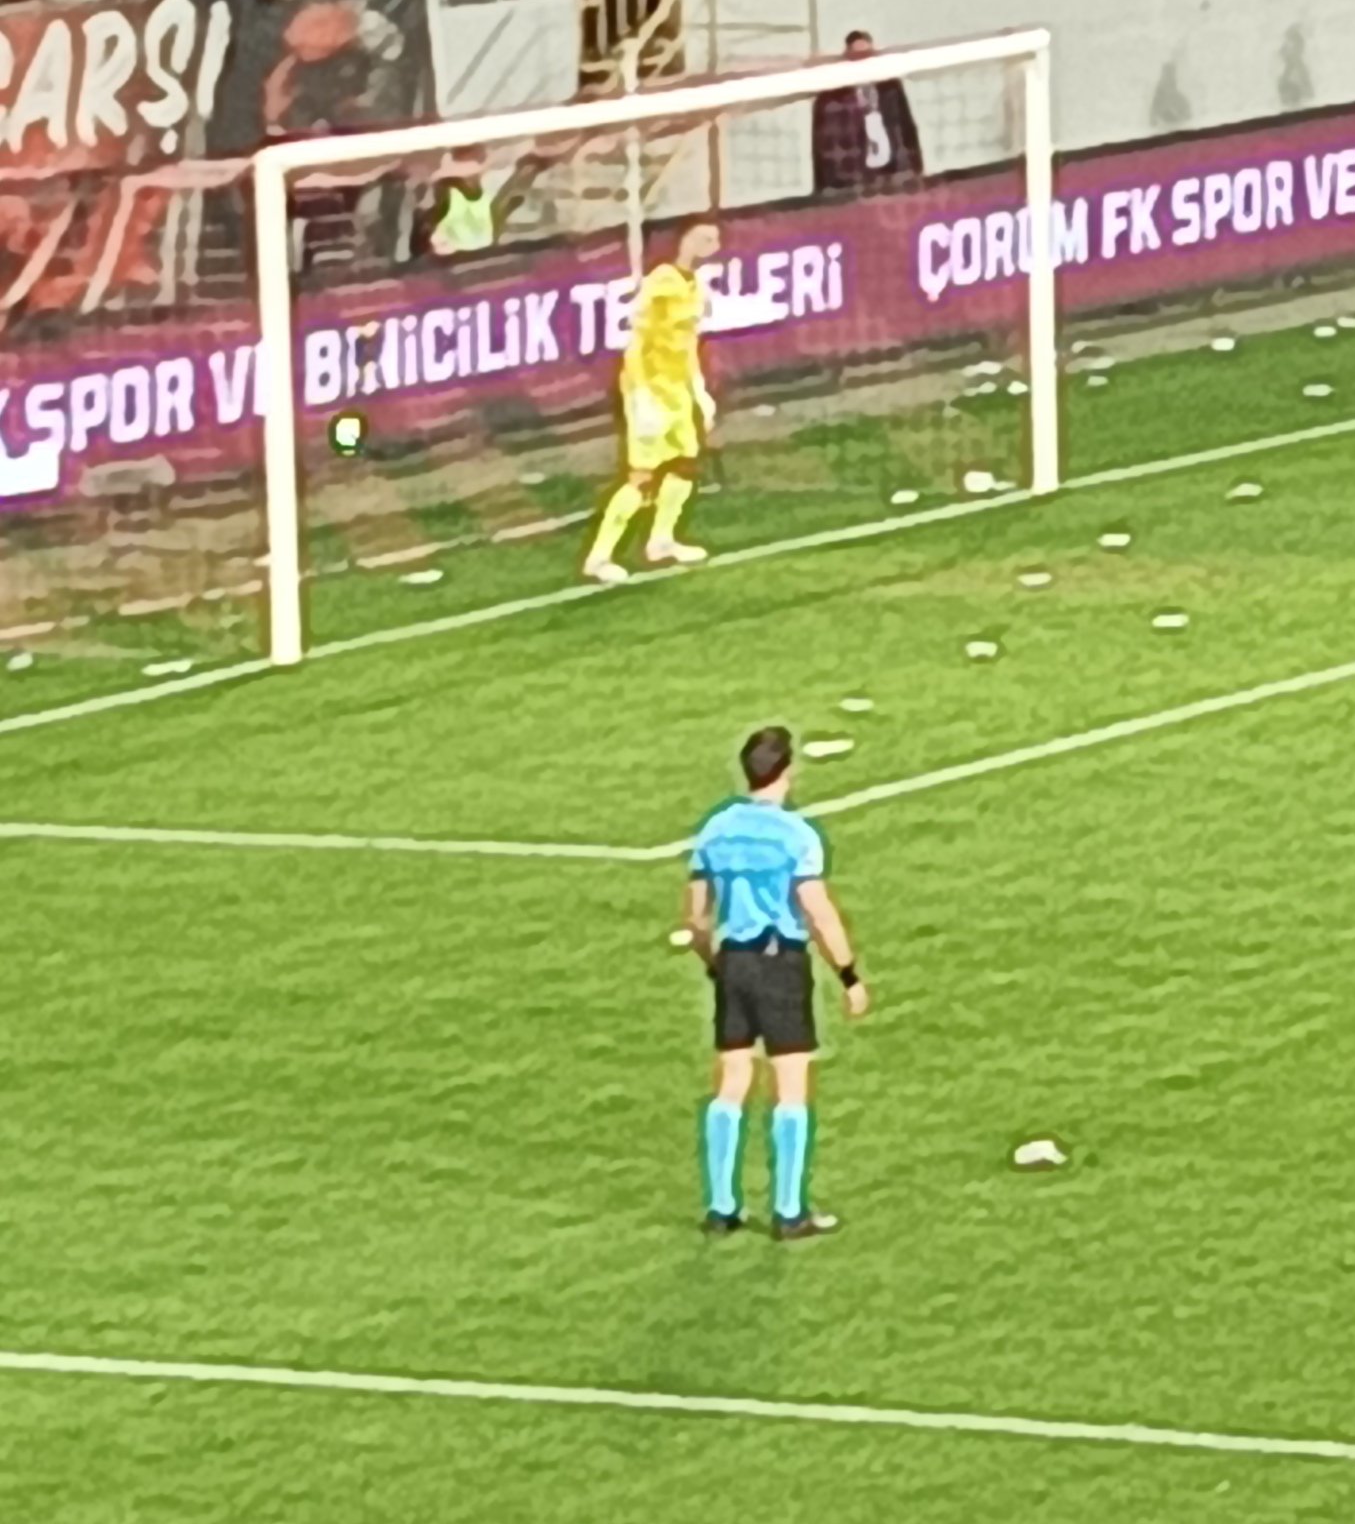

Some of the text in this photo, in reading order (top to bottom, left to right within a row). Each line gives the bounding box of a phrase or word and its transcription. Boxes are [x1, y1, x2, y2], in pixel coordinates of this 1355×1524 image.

[1101, 184, 1161, 259] FK
[1171, 160, 1293, 246] SPOR
[25, 357, 194, 452] SPOR
